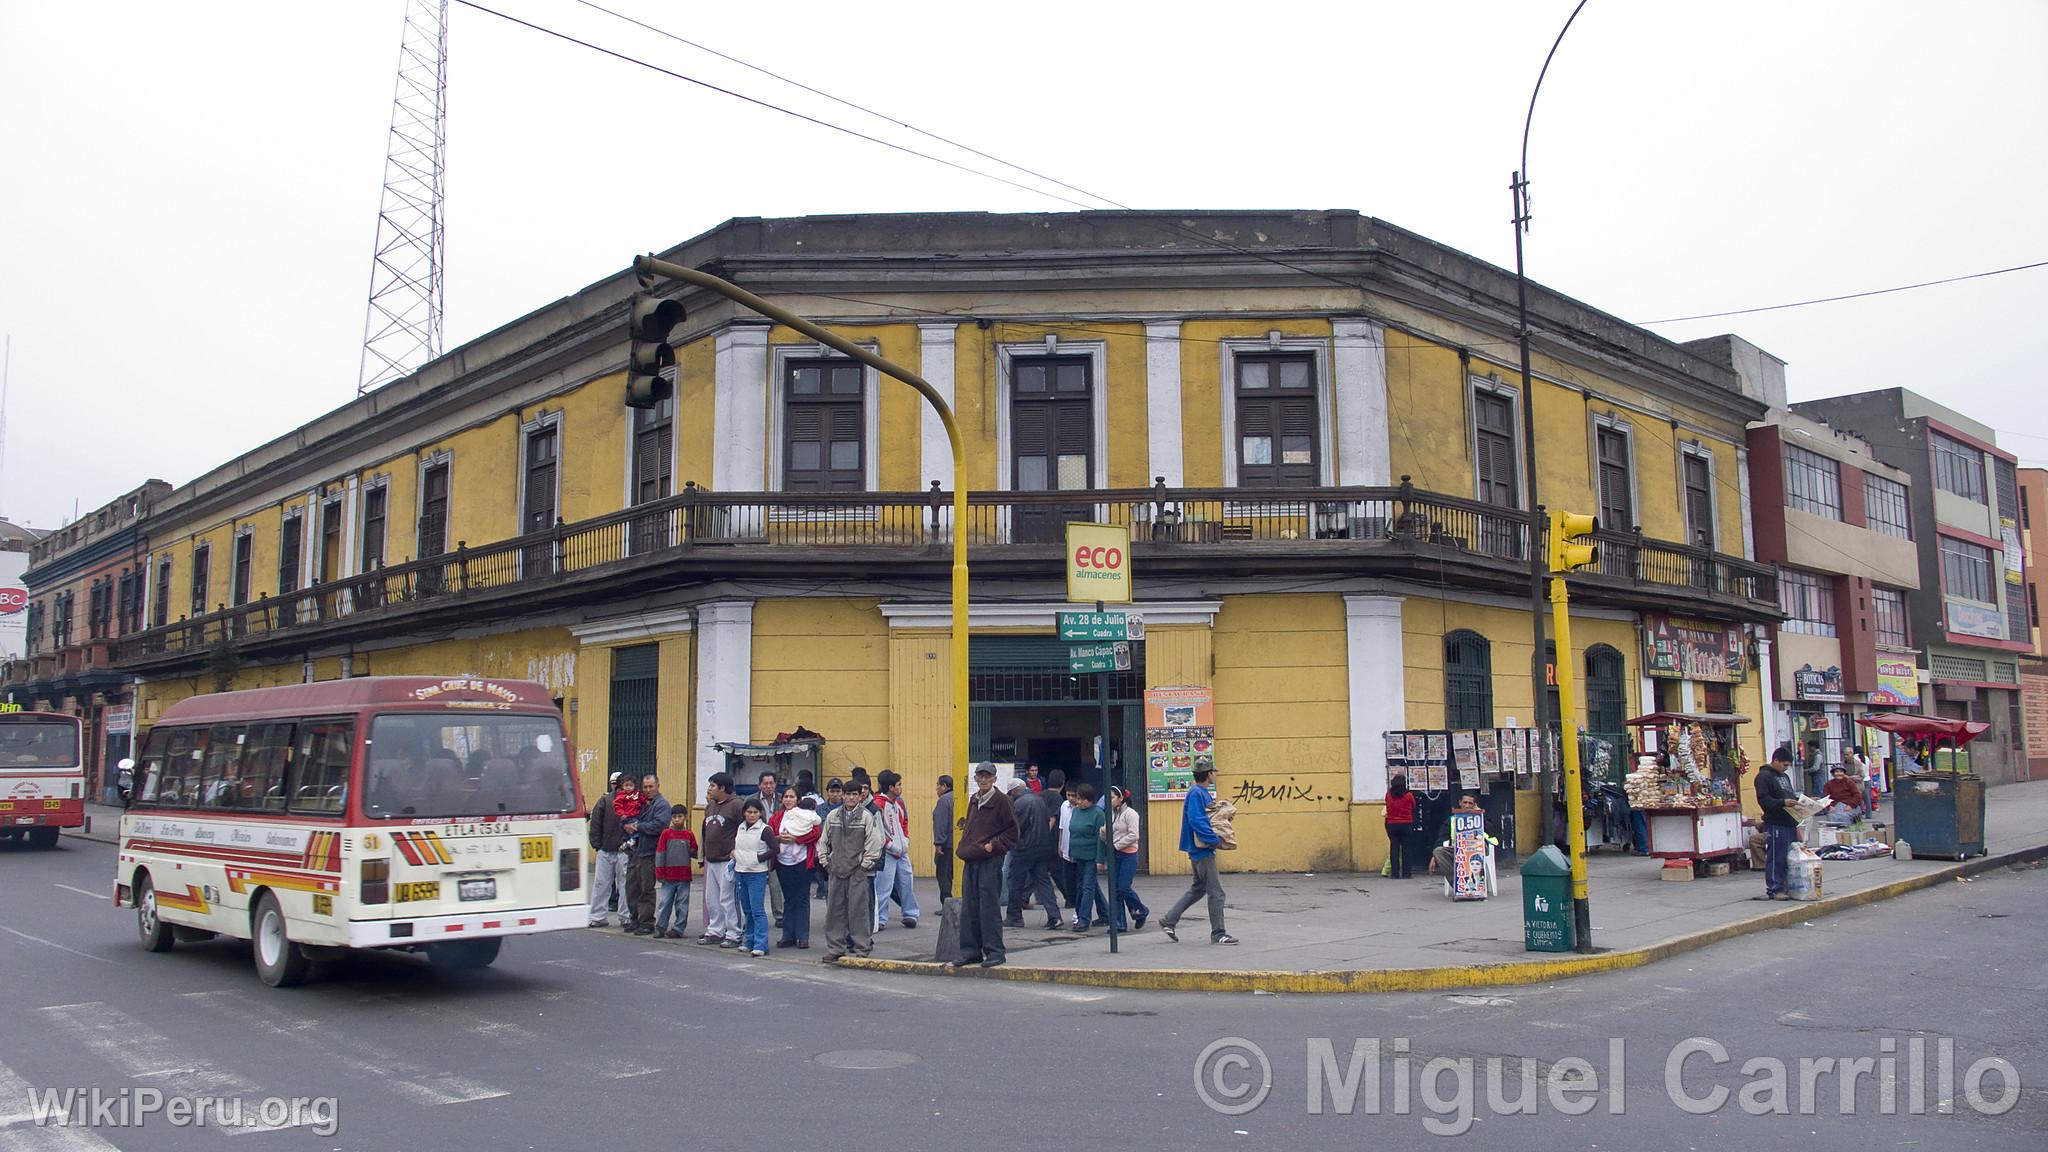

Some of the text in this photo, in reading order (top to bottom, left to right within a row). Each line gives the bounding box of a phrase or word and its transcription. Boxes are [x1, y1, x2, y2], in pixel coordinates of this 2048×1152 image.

[1075, 545, 1122, 570] eco
[1076, 569, 1121, 580] almacenes
[1063, 614, 1125, 626] Av. 28 de Julio
[1092, 628, 1124, 638] Cuadra 14
[1077, 647, 1095, 658] Manco
[1091, 660, 1106, 669] Cuadra
[1803, 673, 1825, 686] BOTICAS
[1457, 815, 1481, 831] 0.50
[363, 836, 378, 849] 31
[1456, 832, 1468, 892] LLAMADAS
